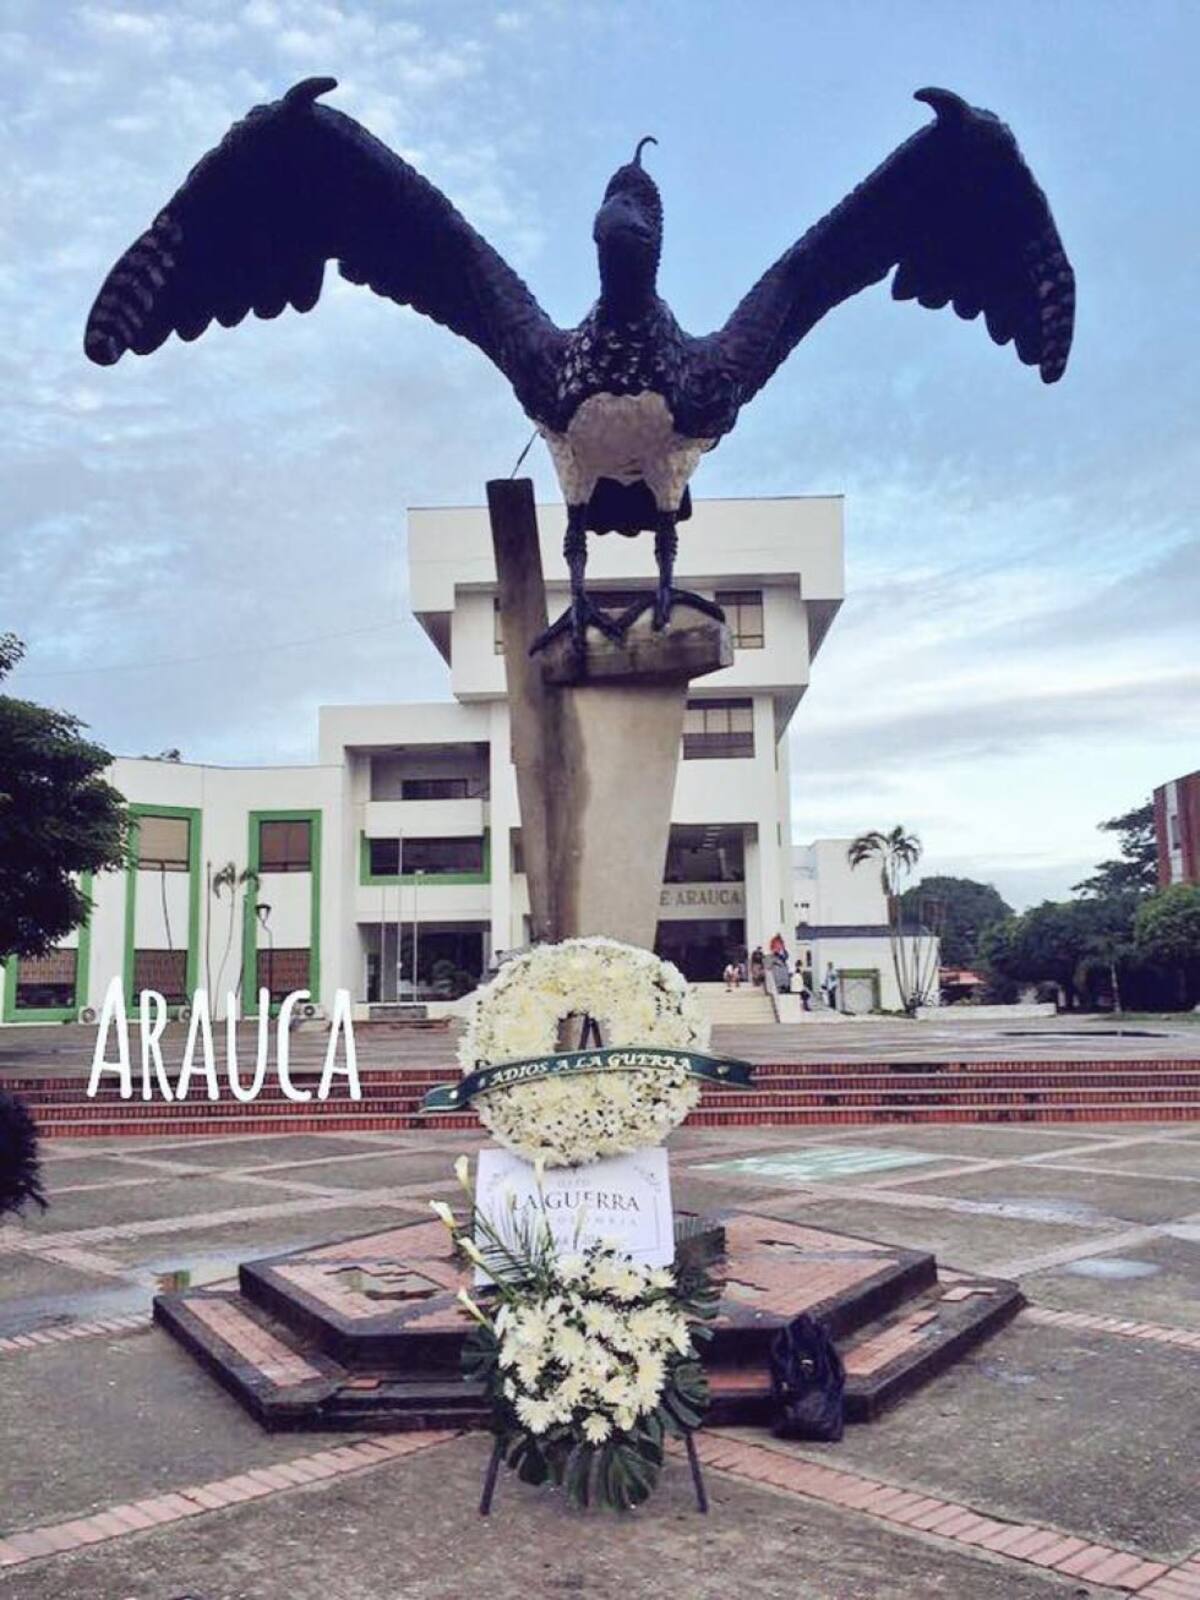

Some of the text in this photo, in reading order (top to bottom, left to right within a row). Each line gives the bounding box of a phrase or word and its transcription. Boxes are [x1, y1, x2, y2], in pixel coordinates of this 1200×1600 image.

[675, 889, 740, 905] ARAUCA
[489, 1053, 692, 1086] ADIOS A LA GUERRA
[544, 1191, 640, 1212] GUERRA
